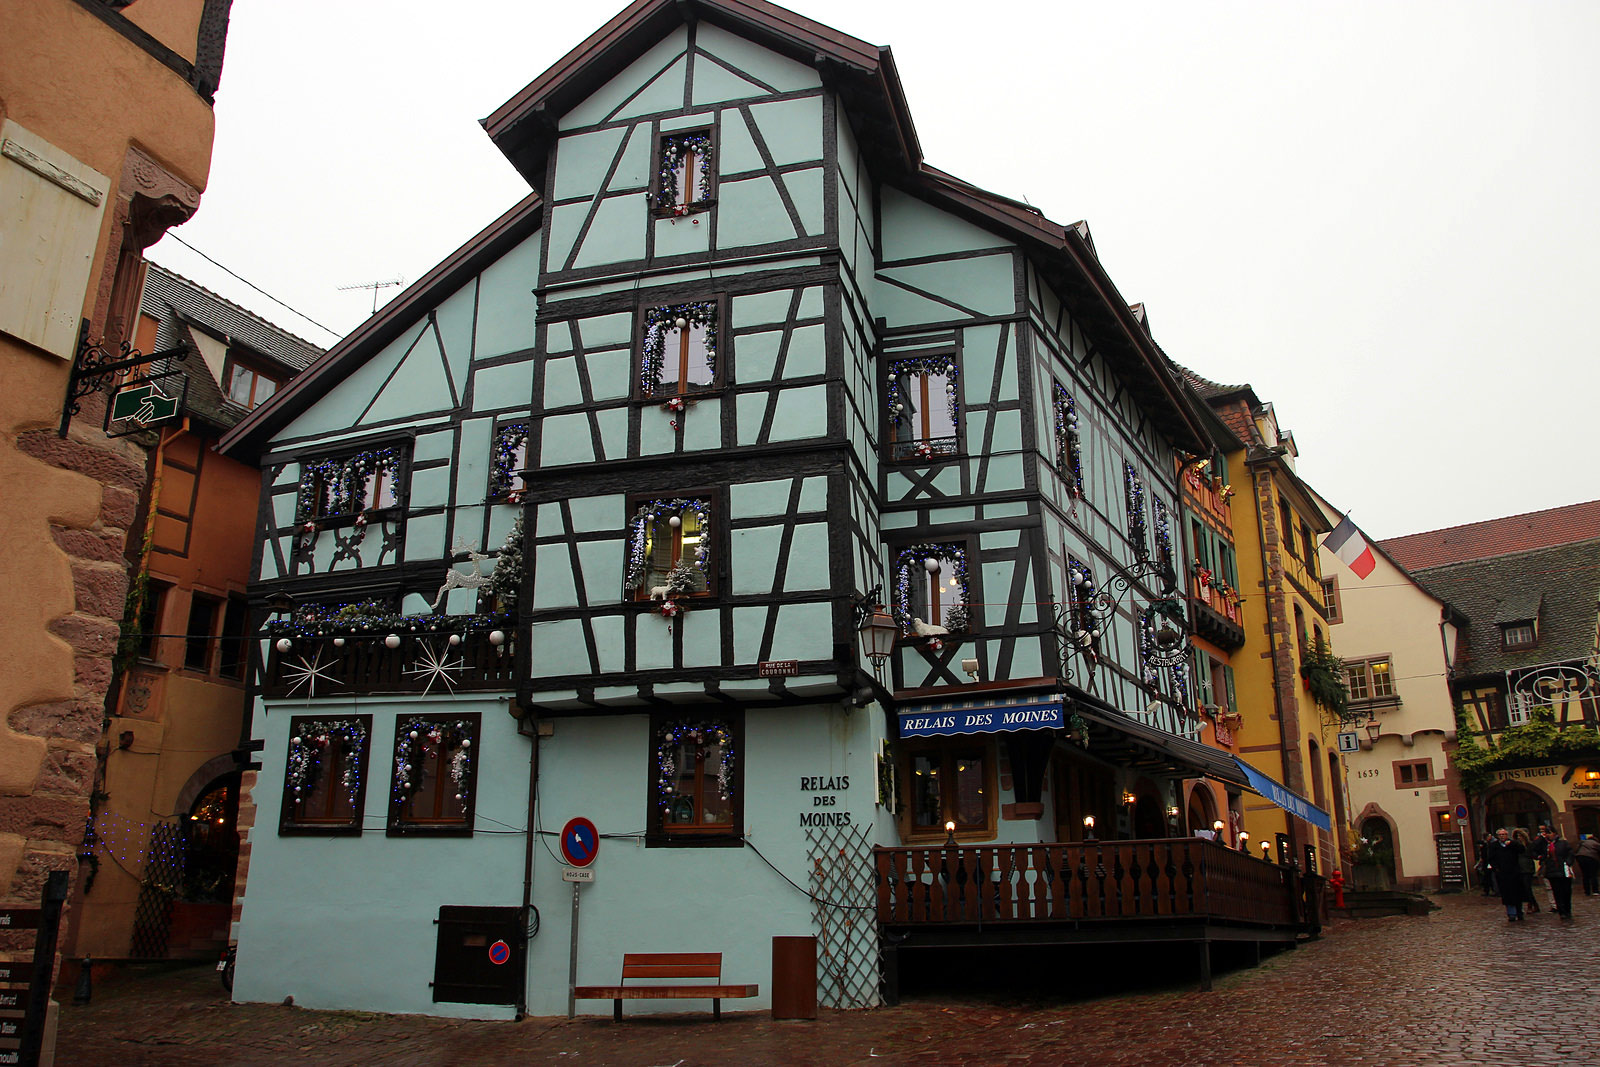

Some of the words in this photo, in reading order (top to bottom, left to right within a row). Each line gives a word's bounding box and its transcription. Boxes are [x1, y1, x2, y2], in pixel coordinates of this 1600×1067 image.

[1149, 650, 1188, 667] RESTAURANT
[904, 716, 956, 730] RELAIS
[965, 713, 993, 726] DES
[1002, 709, 1059, 724] MOINES
[1357, 769, 1380, 778] 1639
[1498, 770, 1521, 780] FINS
[800, 775, 850, 791] RELAIS
[813, 795, 836, 807] DES
[800, 811, 851, 827] MOINES
